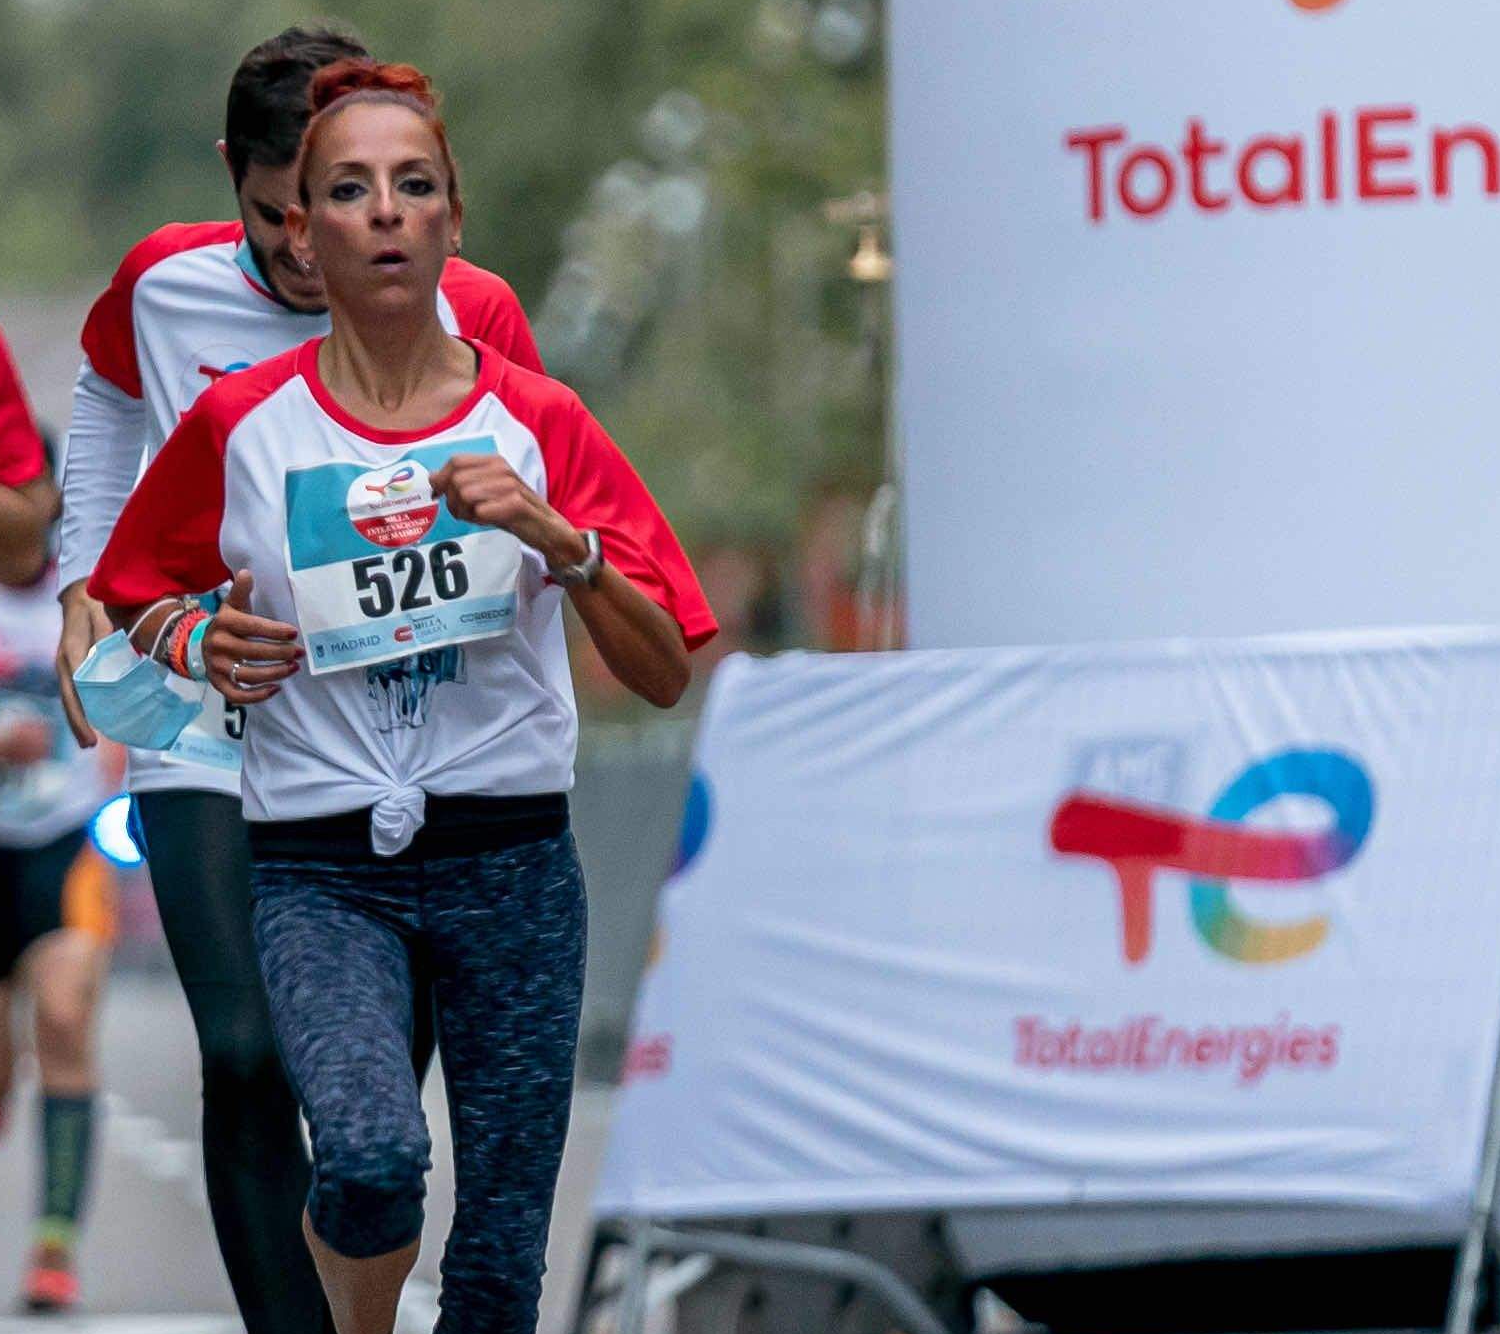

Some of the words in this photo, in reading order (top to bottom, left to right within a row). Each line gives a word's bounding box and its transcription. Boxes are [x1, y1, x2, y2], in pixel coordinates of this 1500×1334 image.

[351, 541, 469, 618] 526
[330, 634, 382, 654] MADRID
[1014, 1011, 1341, 1085] TotalEnergies
